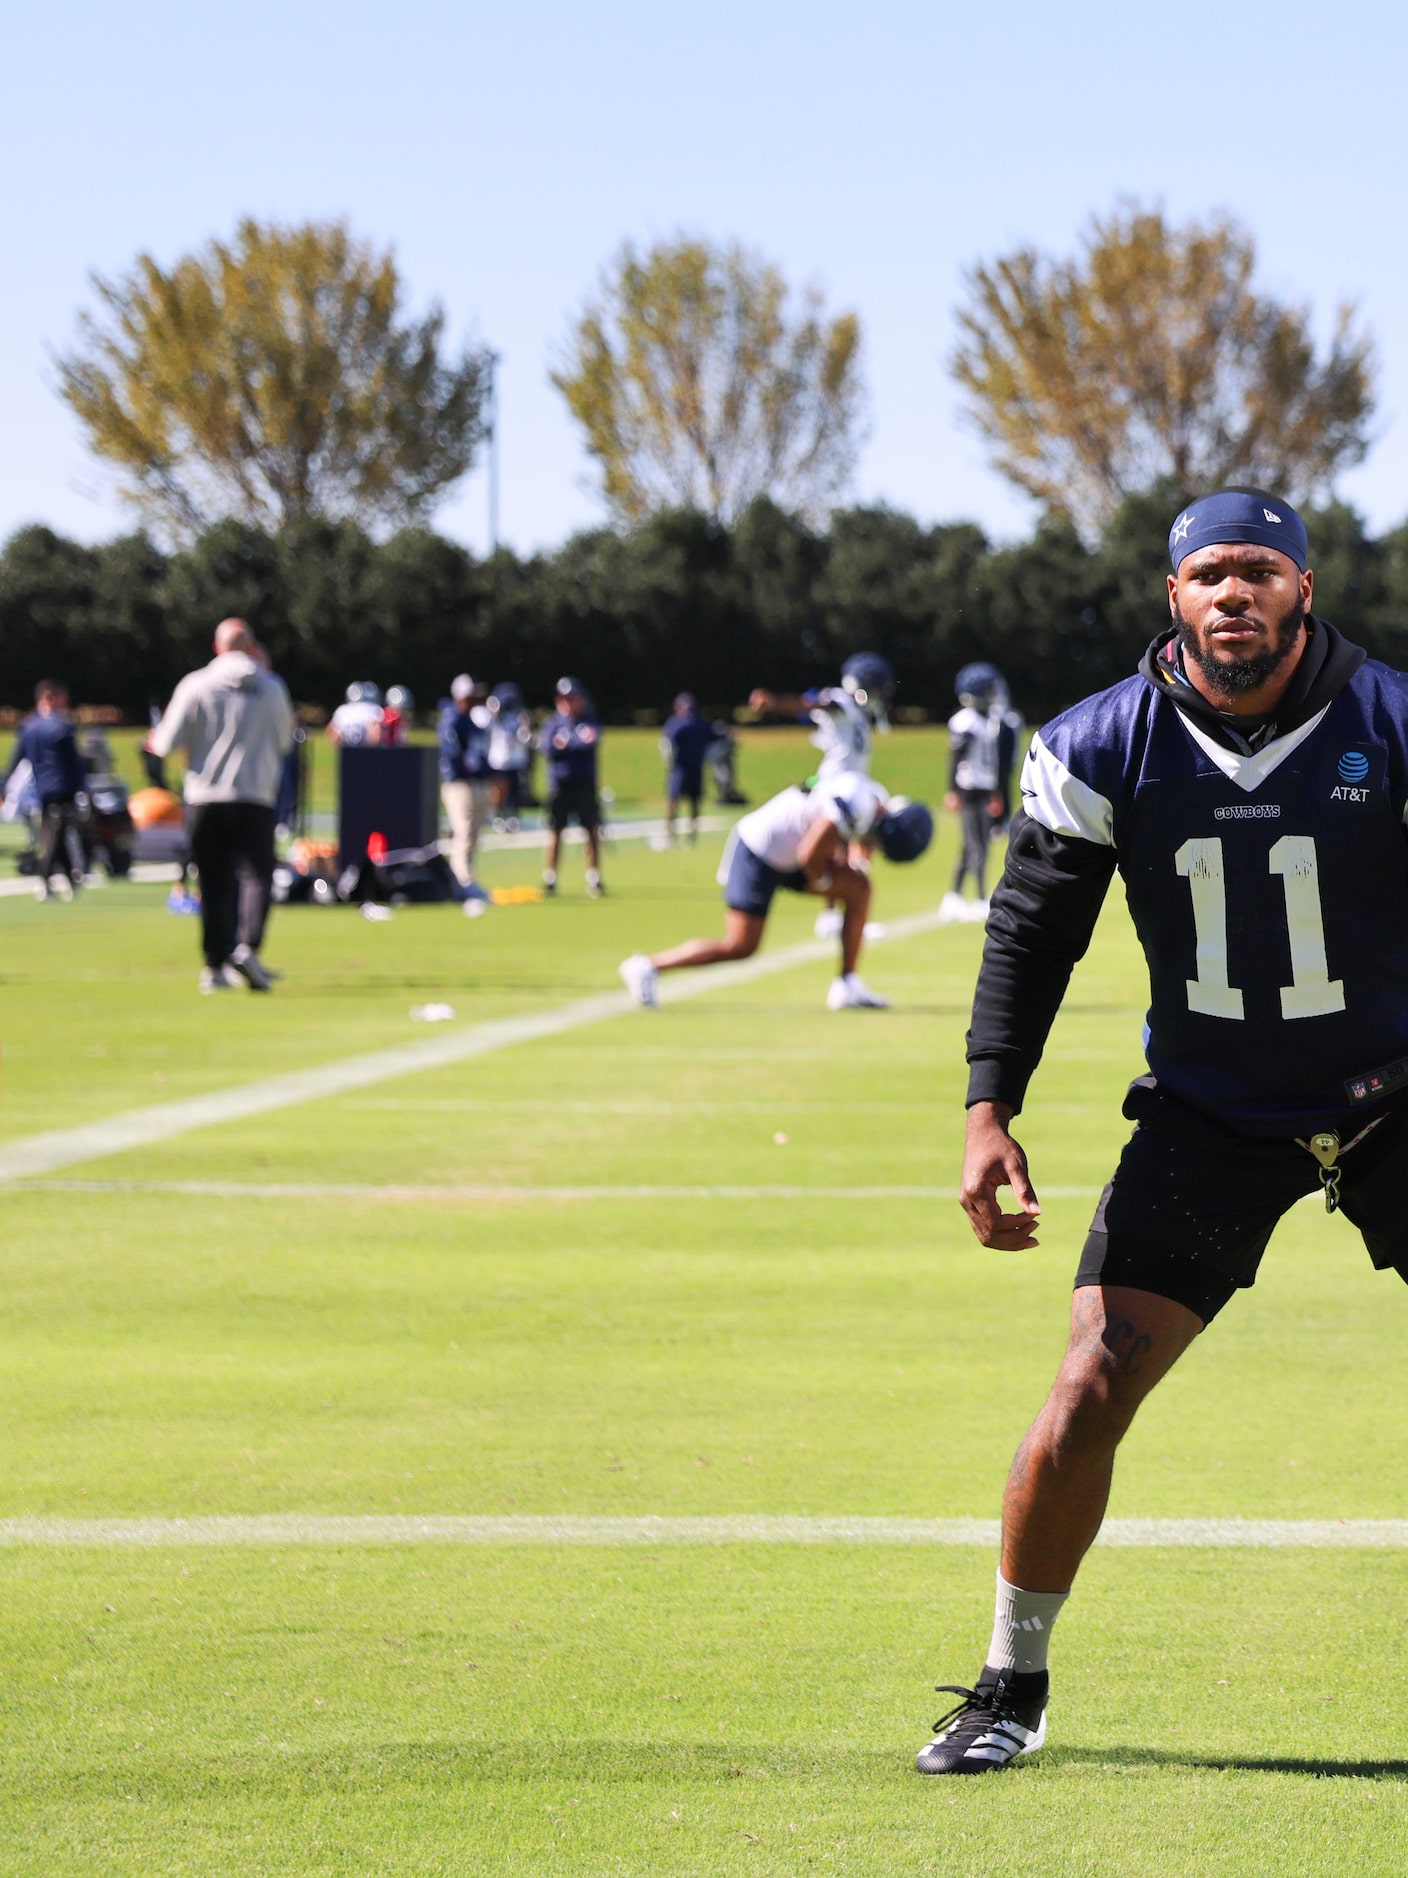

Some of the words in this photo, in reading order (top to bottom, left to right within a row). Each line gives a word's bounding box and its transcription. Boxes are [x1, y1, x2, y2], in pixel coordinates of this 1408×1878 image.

[1330, 786, 1370, 803] AT&T
[1214, 805, 1281, 820] COWBOYS
[1174, 835, 1346, 1021] 11
